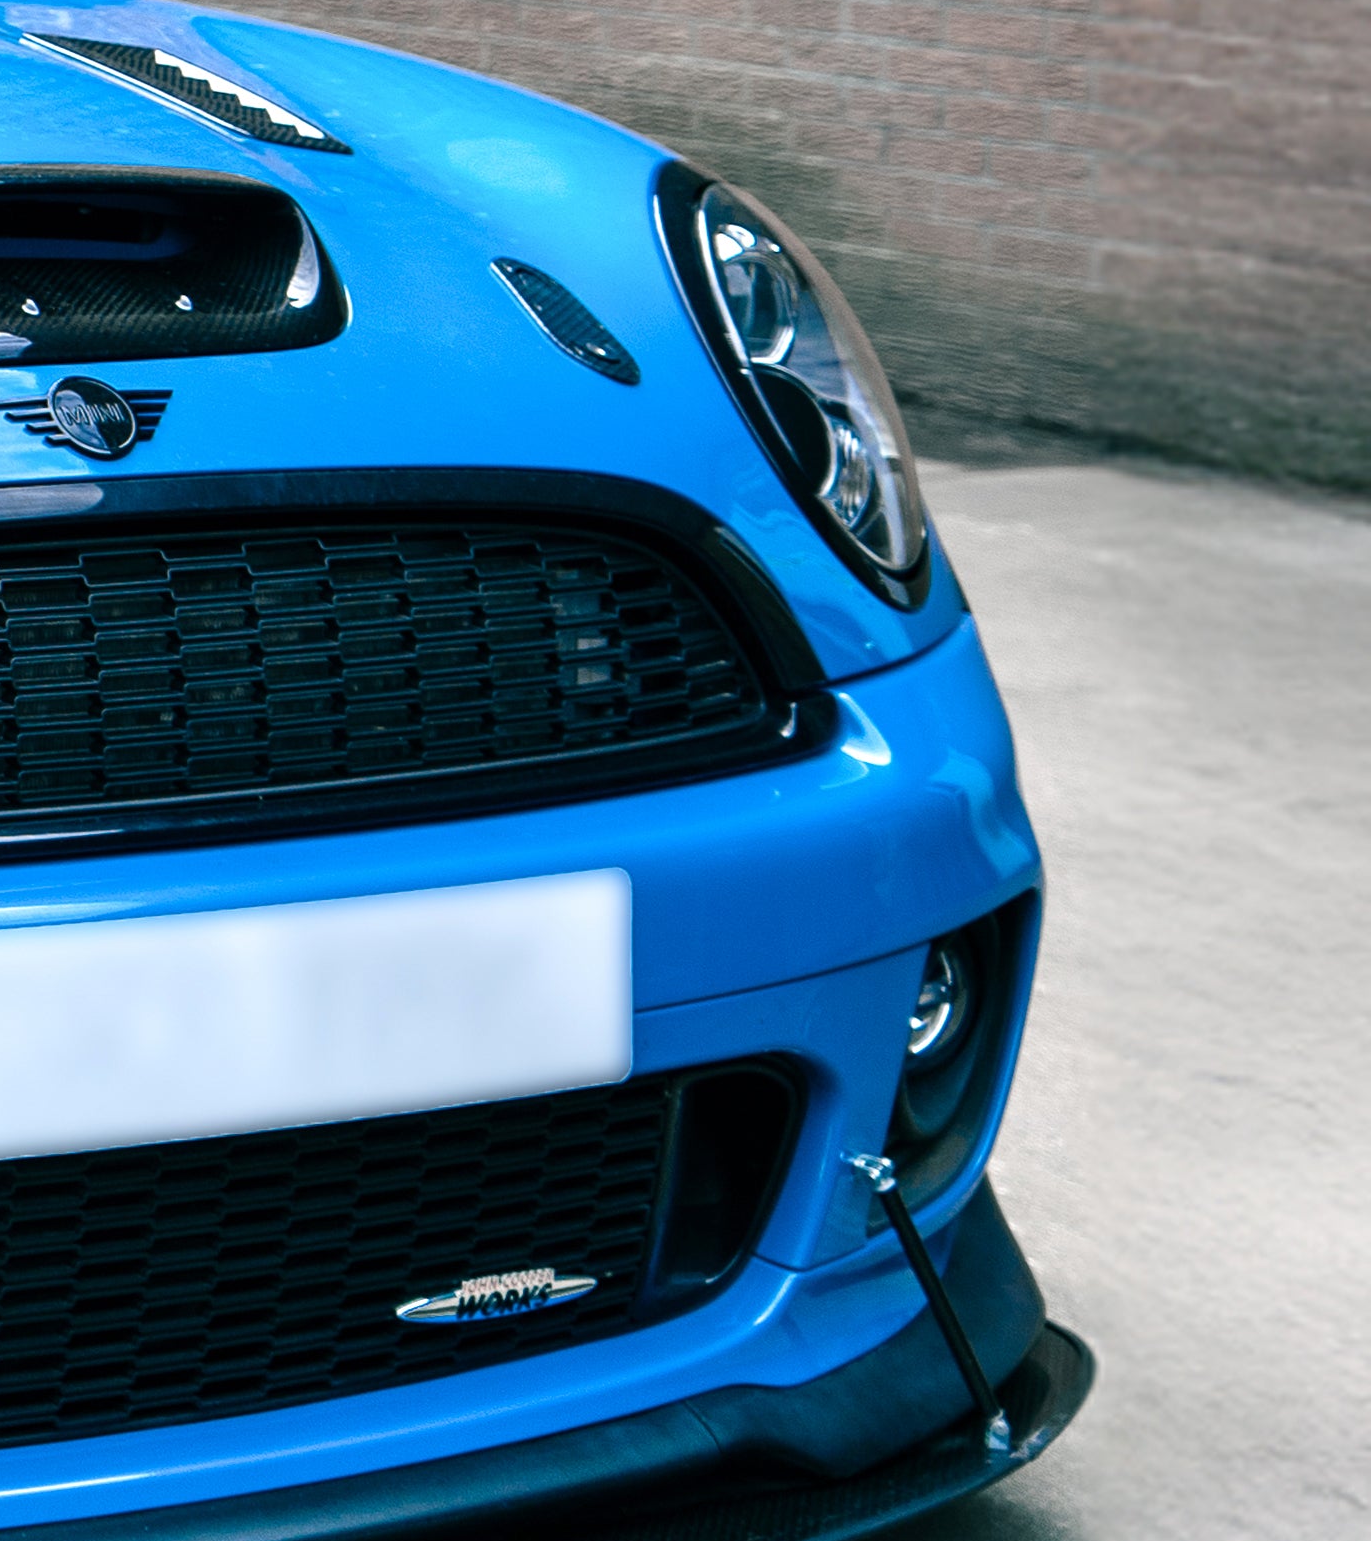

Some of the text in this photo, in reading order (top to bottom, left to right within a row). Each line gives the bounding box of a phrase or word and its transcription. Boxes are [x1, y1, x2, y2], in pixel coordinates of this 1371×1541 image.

[59, 403, 124, 426] MINI
[462, 1268, 555, 1293] JOHN COOPER
[456, 1282, 553, 1319] WORKS
